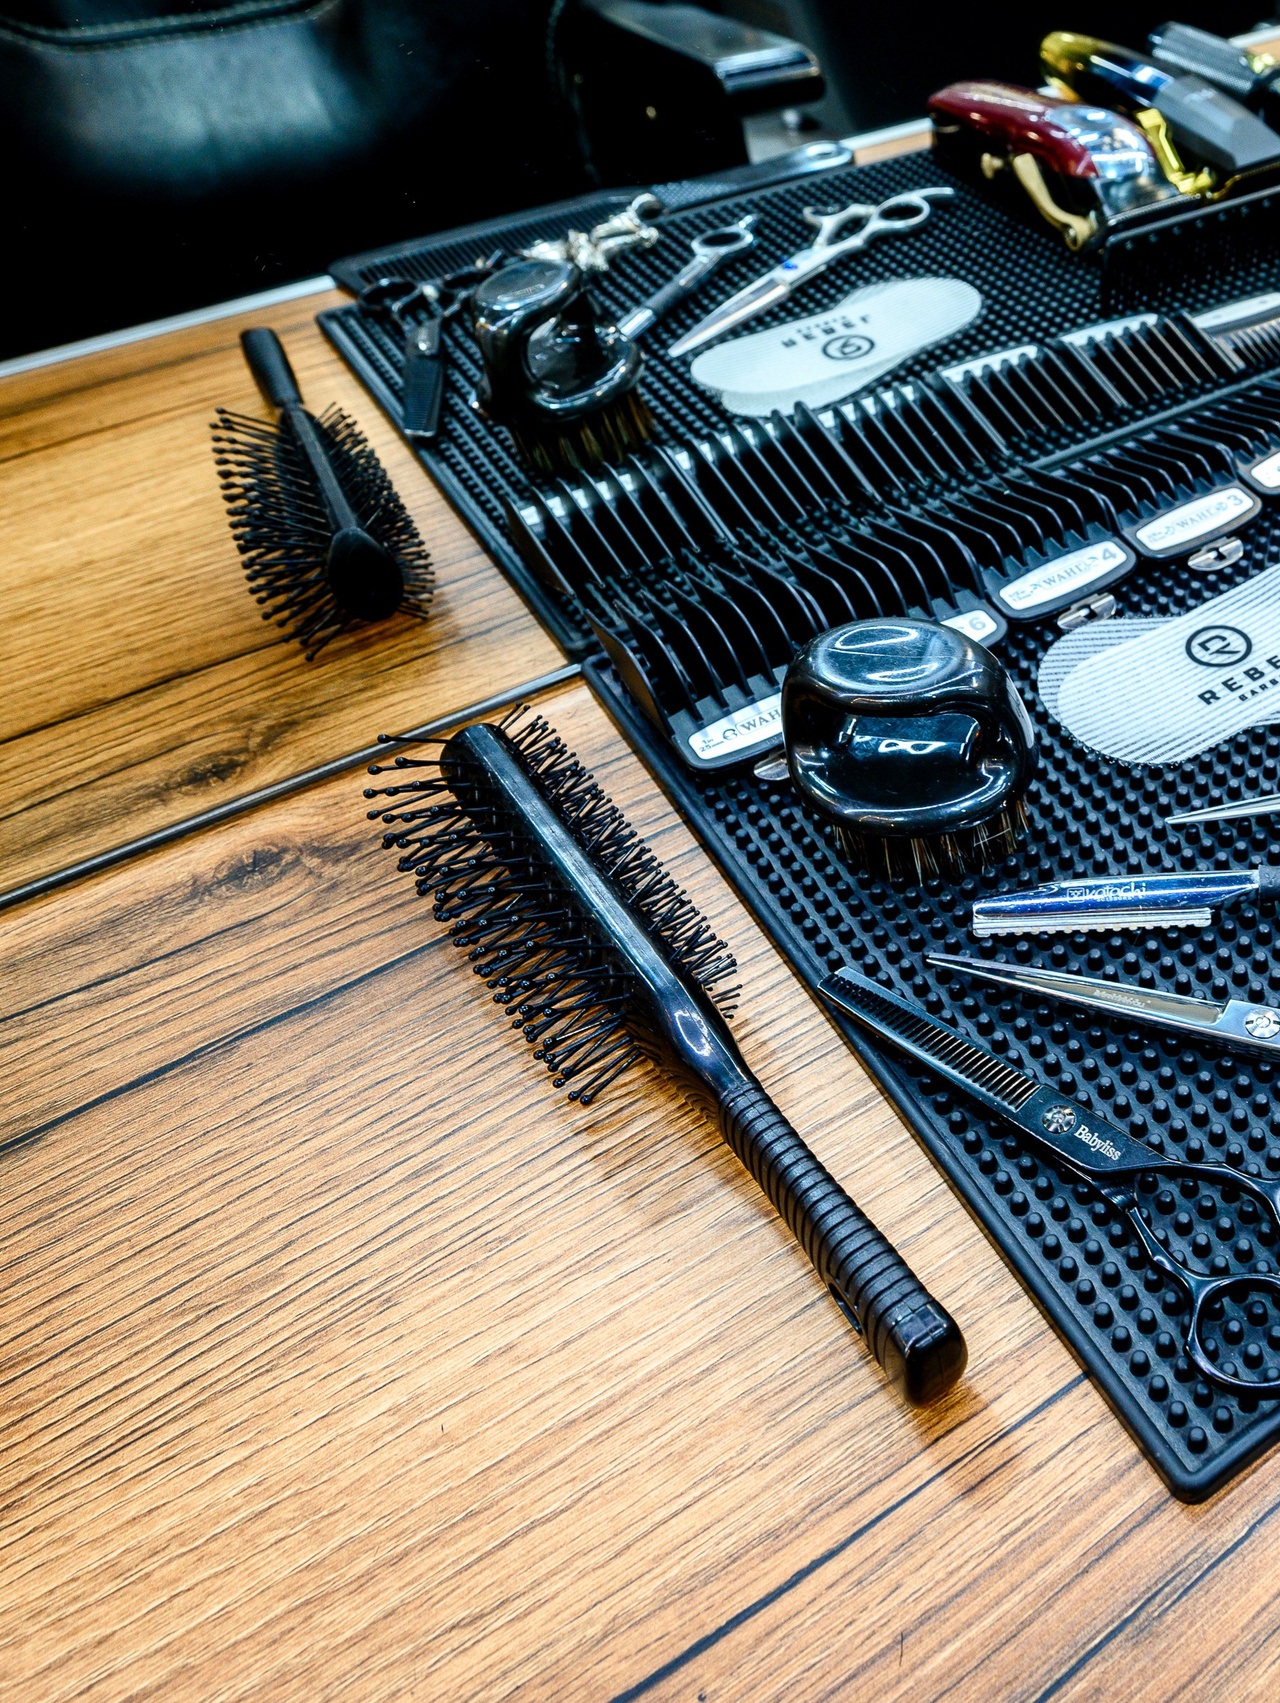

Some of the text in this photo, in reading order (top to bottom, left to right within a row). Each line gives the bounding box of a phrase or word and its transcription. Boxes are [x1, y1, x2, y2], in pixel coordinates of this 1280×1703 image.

[1227, 494, 1243, 506] 3
[1102, 548, 1117, 561] 4
[968, 616, 986, 631] 6
[741, 708, 781, 732] WAH
[1074, 1125, 1121, 1161] Babyliss
